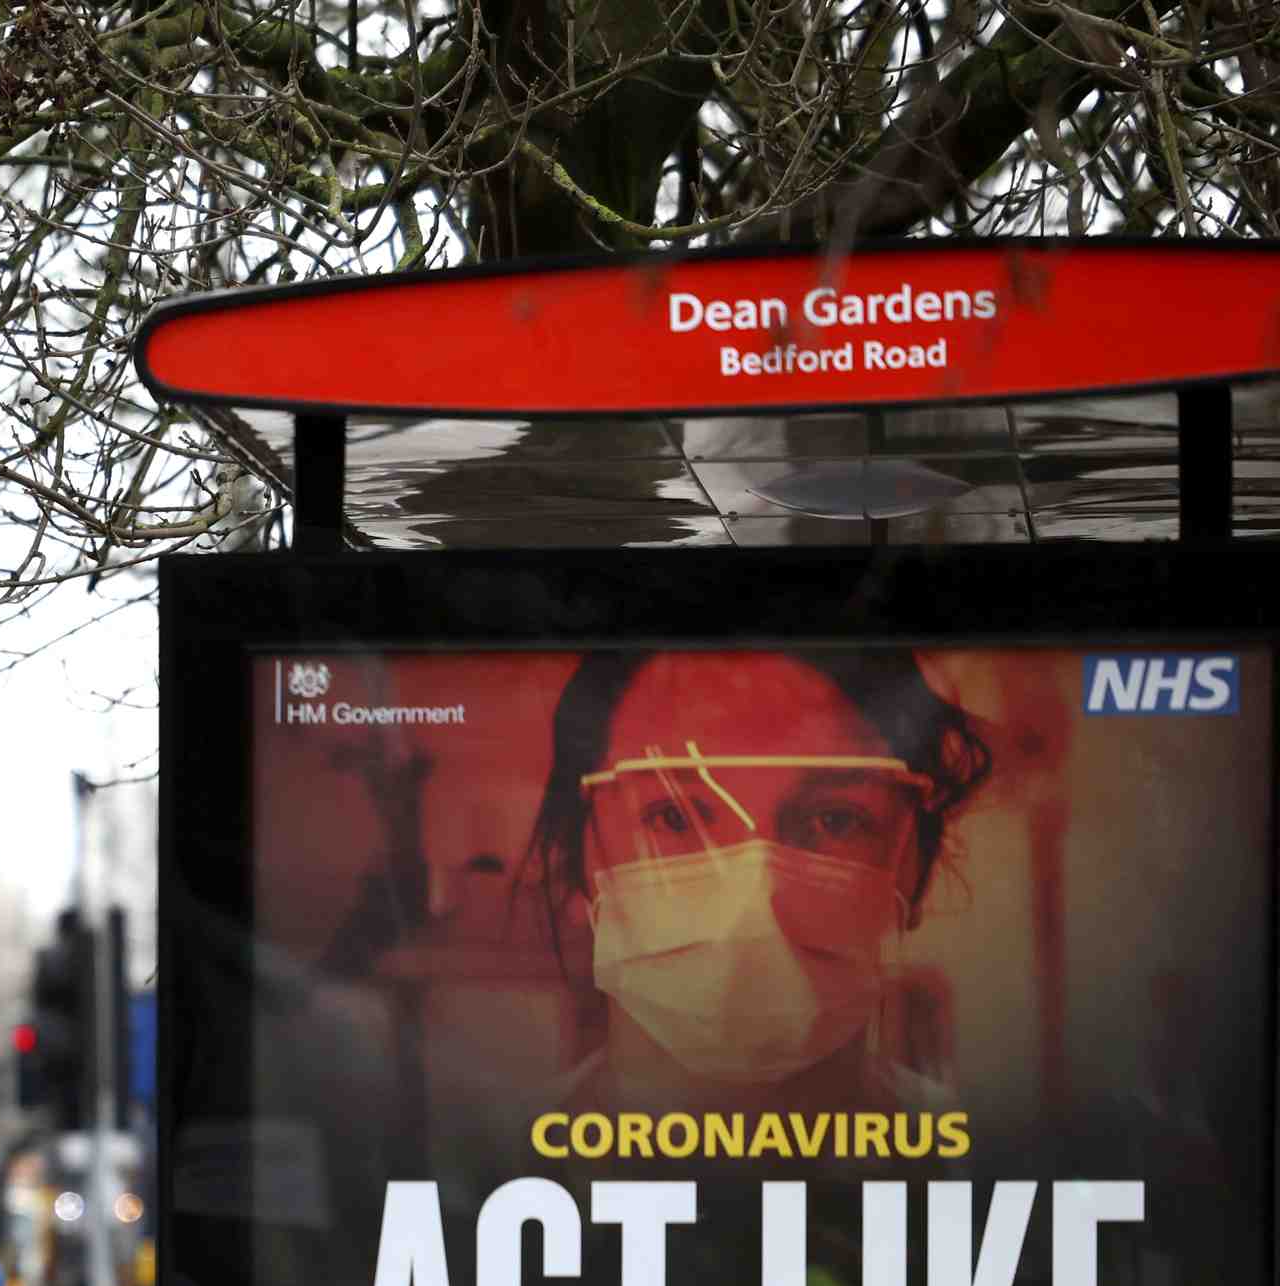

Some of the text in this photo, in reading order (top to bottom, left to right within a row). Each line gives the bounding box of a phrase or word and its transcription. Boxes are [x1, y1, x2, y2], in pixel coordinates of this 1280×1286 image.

[670, 284, 996, 332] Dean Gardens
[720, 338, 947, 376] Bedford Road
[1088, 658, 1234, 711] NHS
[287, 702, 465, 725] HM Government
[531, 1112, 970, 1158] CORONAVIRUS
